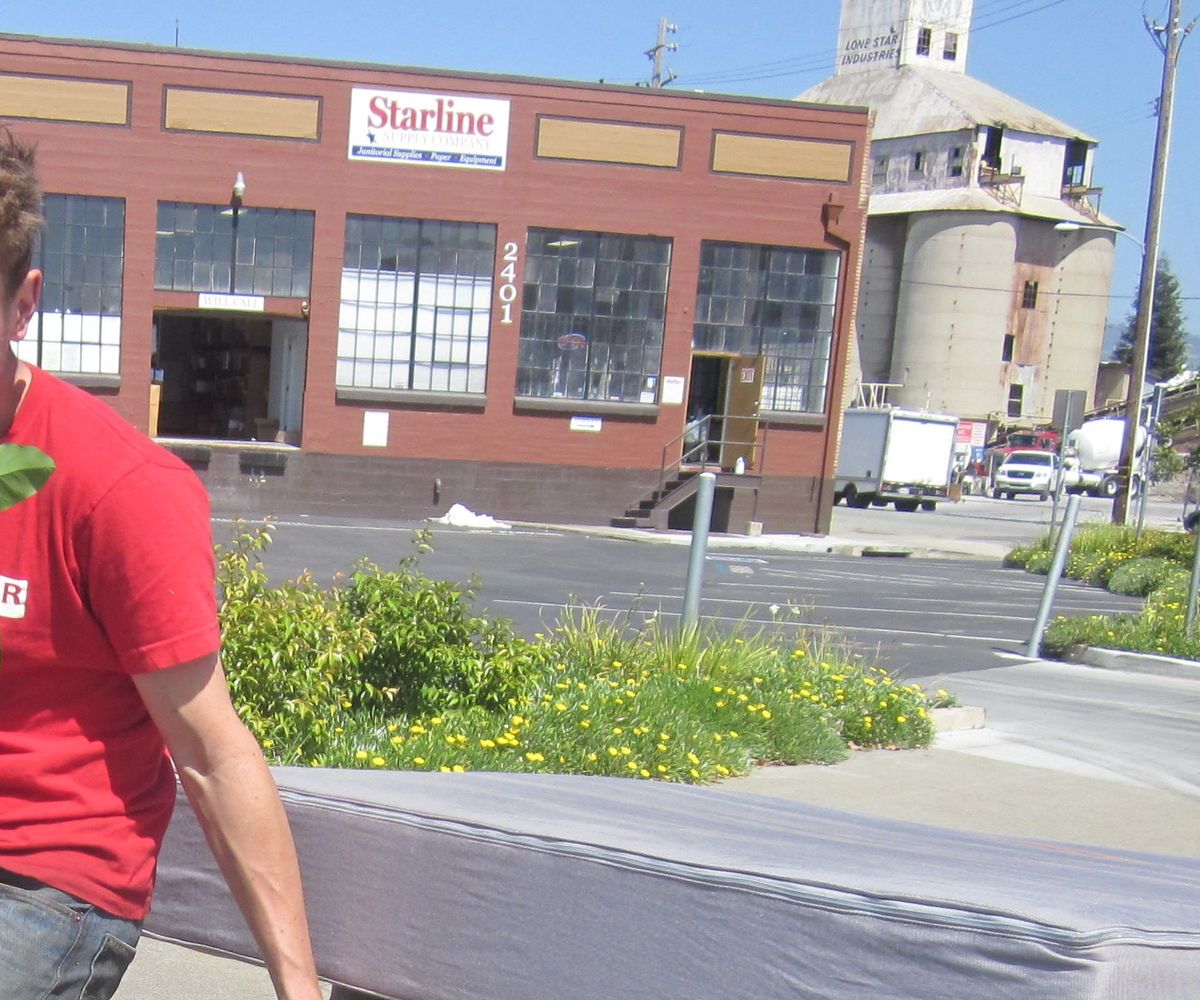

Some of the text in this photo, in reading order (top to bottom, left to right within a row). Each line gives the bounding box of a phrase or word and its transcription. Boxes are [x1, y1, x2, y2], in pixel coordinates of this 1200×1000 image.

[845, 34, 898, 51] LONE STAR
[367, 95, 494, 137] Starline
[393, 149, 423, 160] Supplies
[430, 151, 452, 162] Paper
[459, 154, 498, 165] Equipment
[499, 242, 518, 324] 2401
